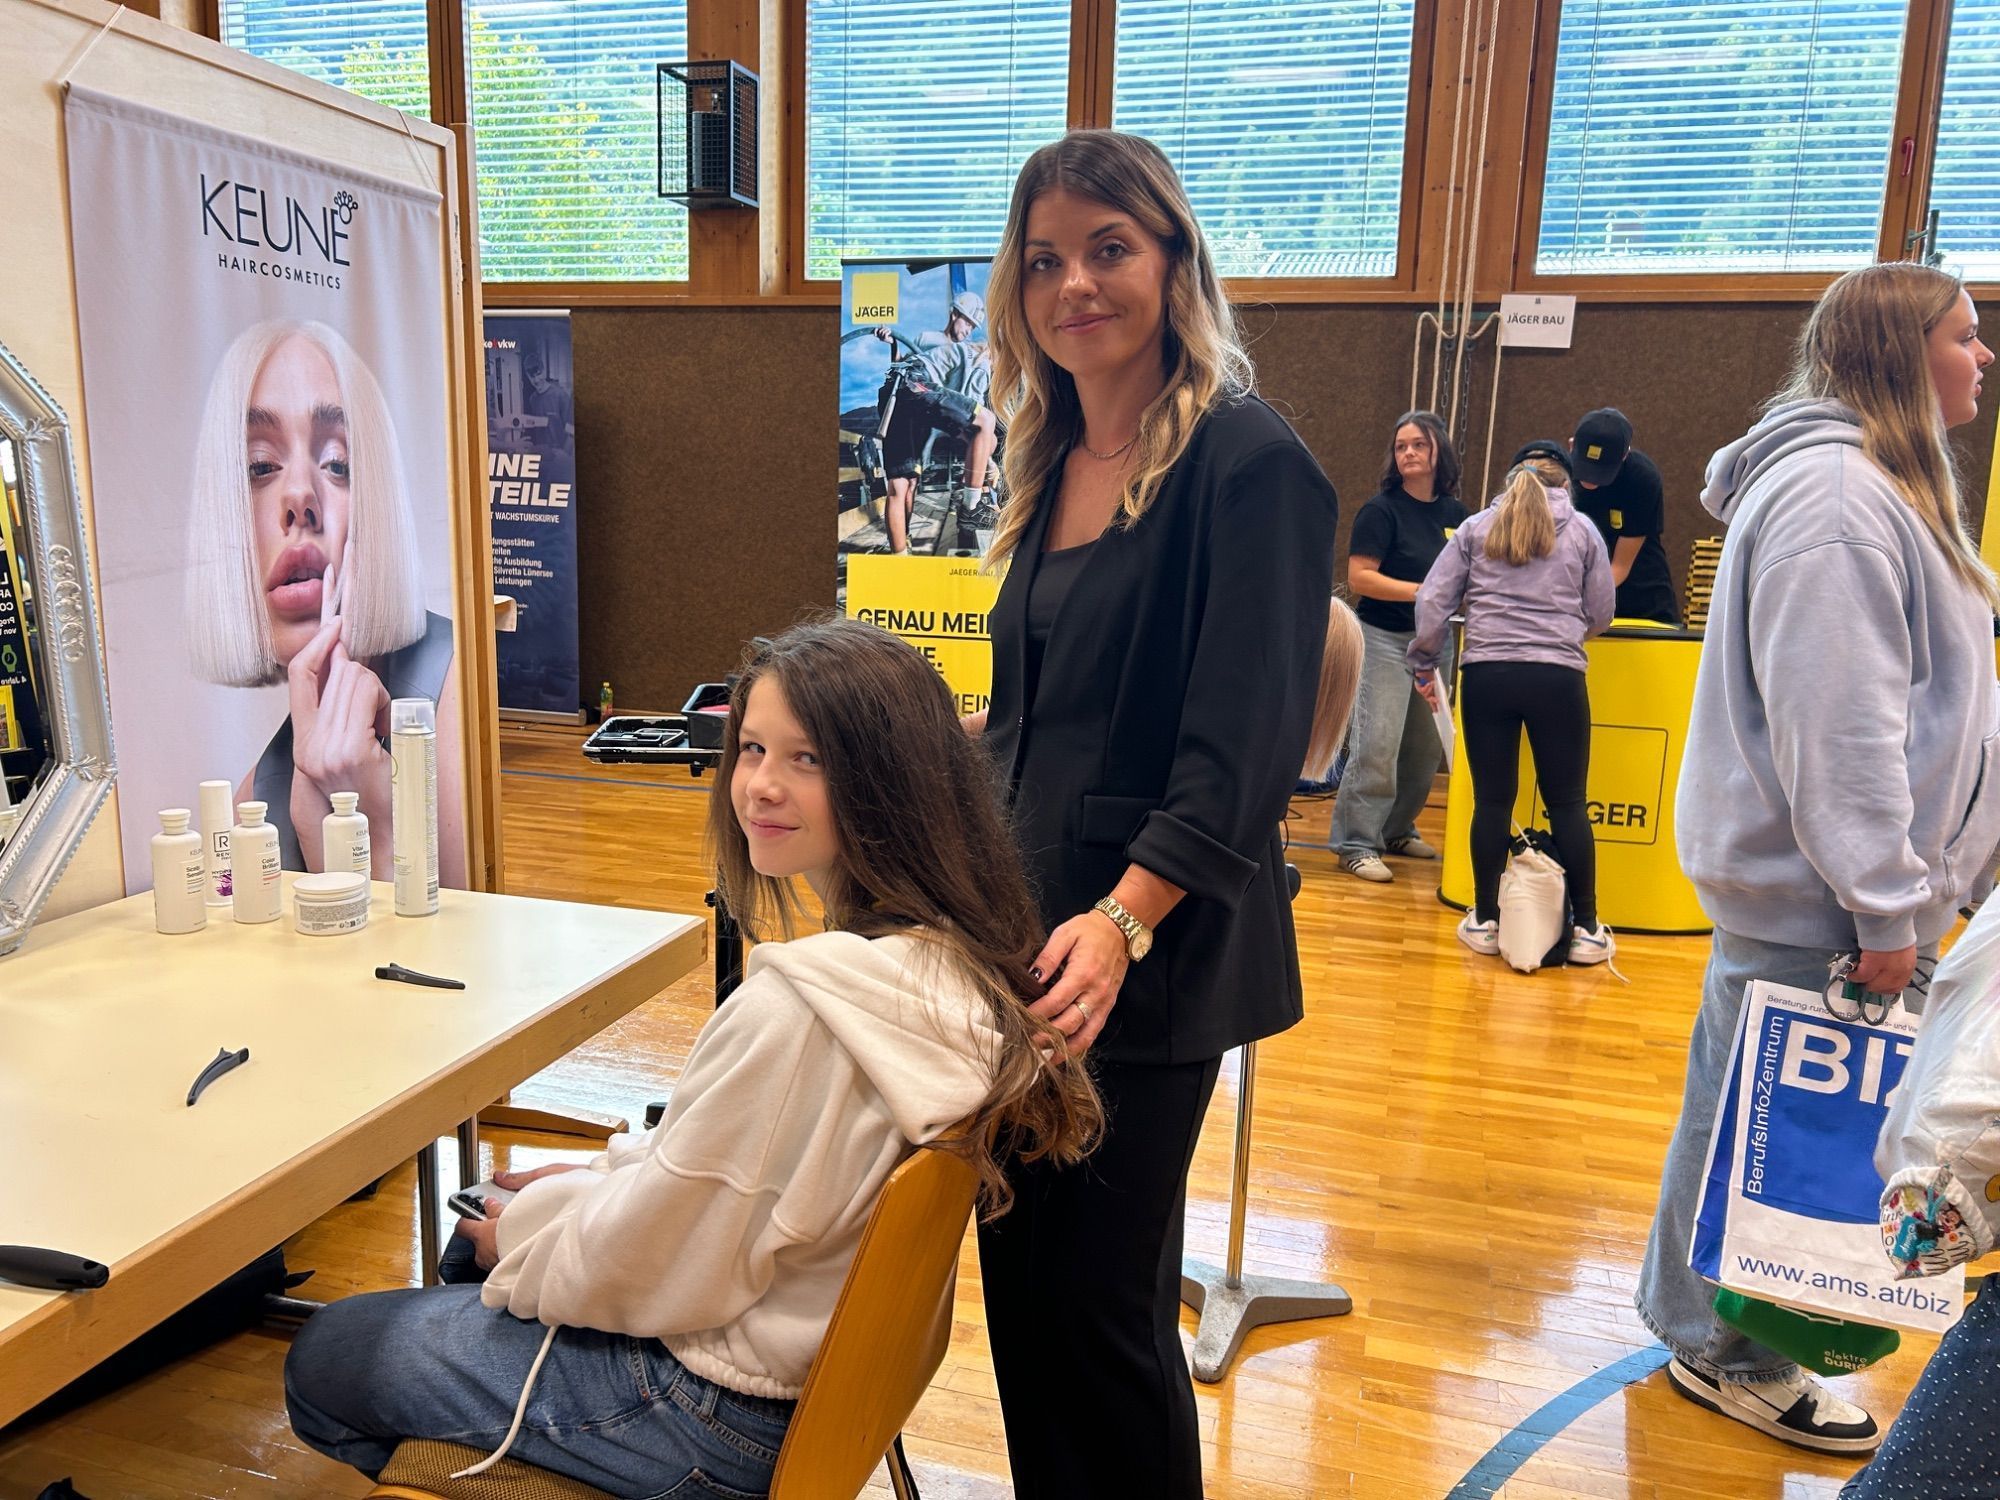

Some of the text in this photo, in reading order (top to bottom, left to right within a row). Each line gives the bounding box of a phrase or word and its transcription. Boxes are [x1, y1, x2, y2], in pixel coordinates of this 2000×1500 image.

[200, 173, 350, 267] KEUNE
[218, 253, 341, 290] HAIRCOSMETICS
[855, 306, 895, 318] JÄGER
[1507, 313, 1565, 325] JÄGER BAU
[495, 511, 560, 524] WACHSTUMSKURVE
[503, 556, 542, 569] Ausbildung
[495, 576, 533, 587] Leistungen
[857, 608, 935, 632] GENAU
[1767, 994, 1808, 1010] Beratung
[1747, 1016, 1785, 1196] BerufsInfoZentrum
[1737, 1255, 1951, 1316] www.ams.at/biz
[1824, 1349, 1867, 1363] elektro
